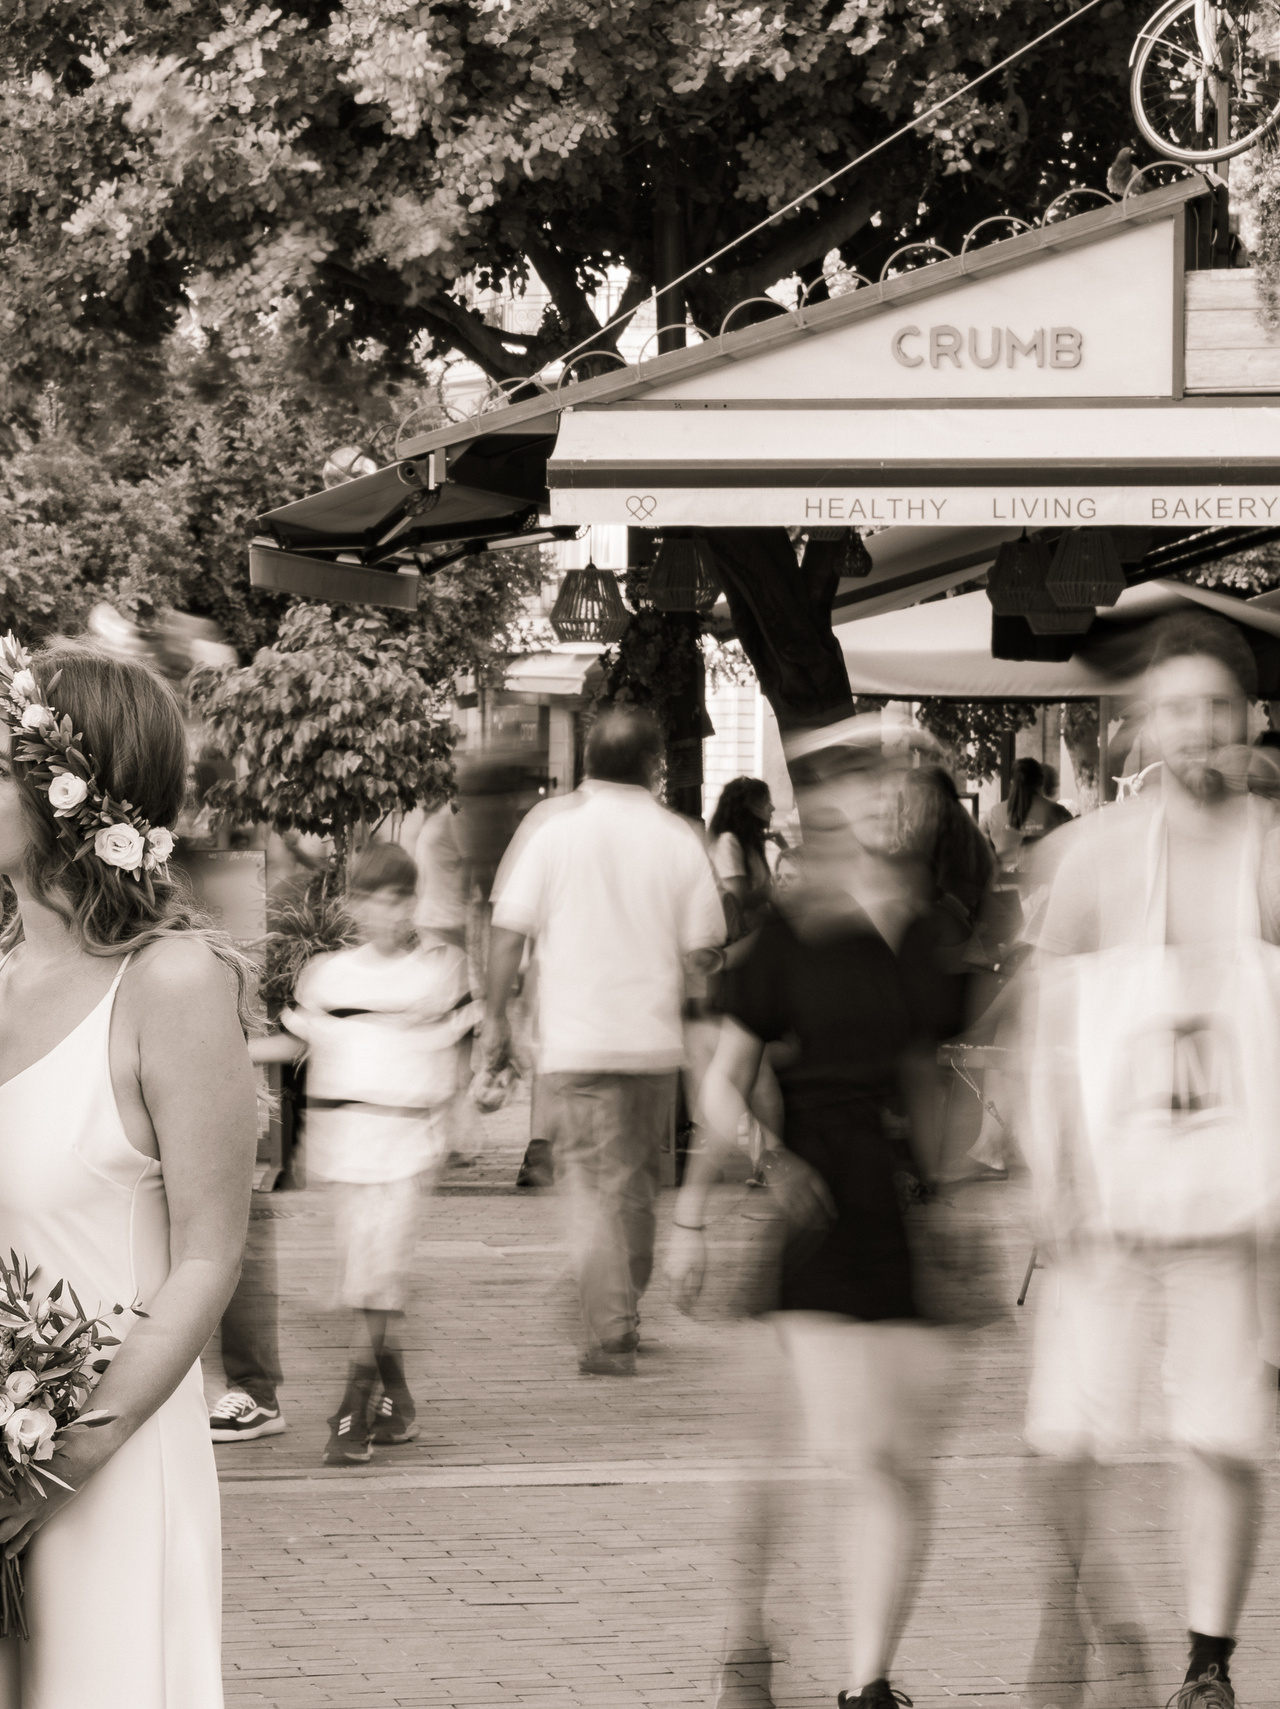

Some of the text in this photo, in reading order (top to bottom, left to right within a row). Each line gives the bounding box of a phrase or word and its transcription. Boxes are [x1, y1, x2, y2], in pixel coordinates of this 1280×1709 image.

[892, 325, 1082, 369] CRUMB
[805, 497, 1279, 520] HEALTHY LIVING BAKERY
